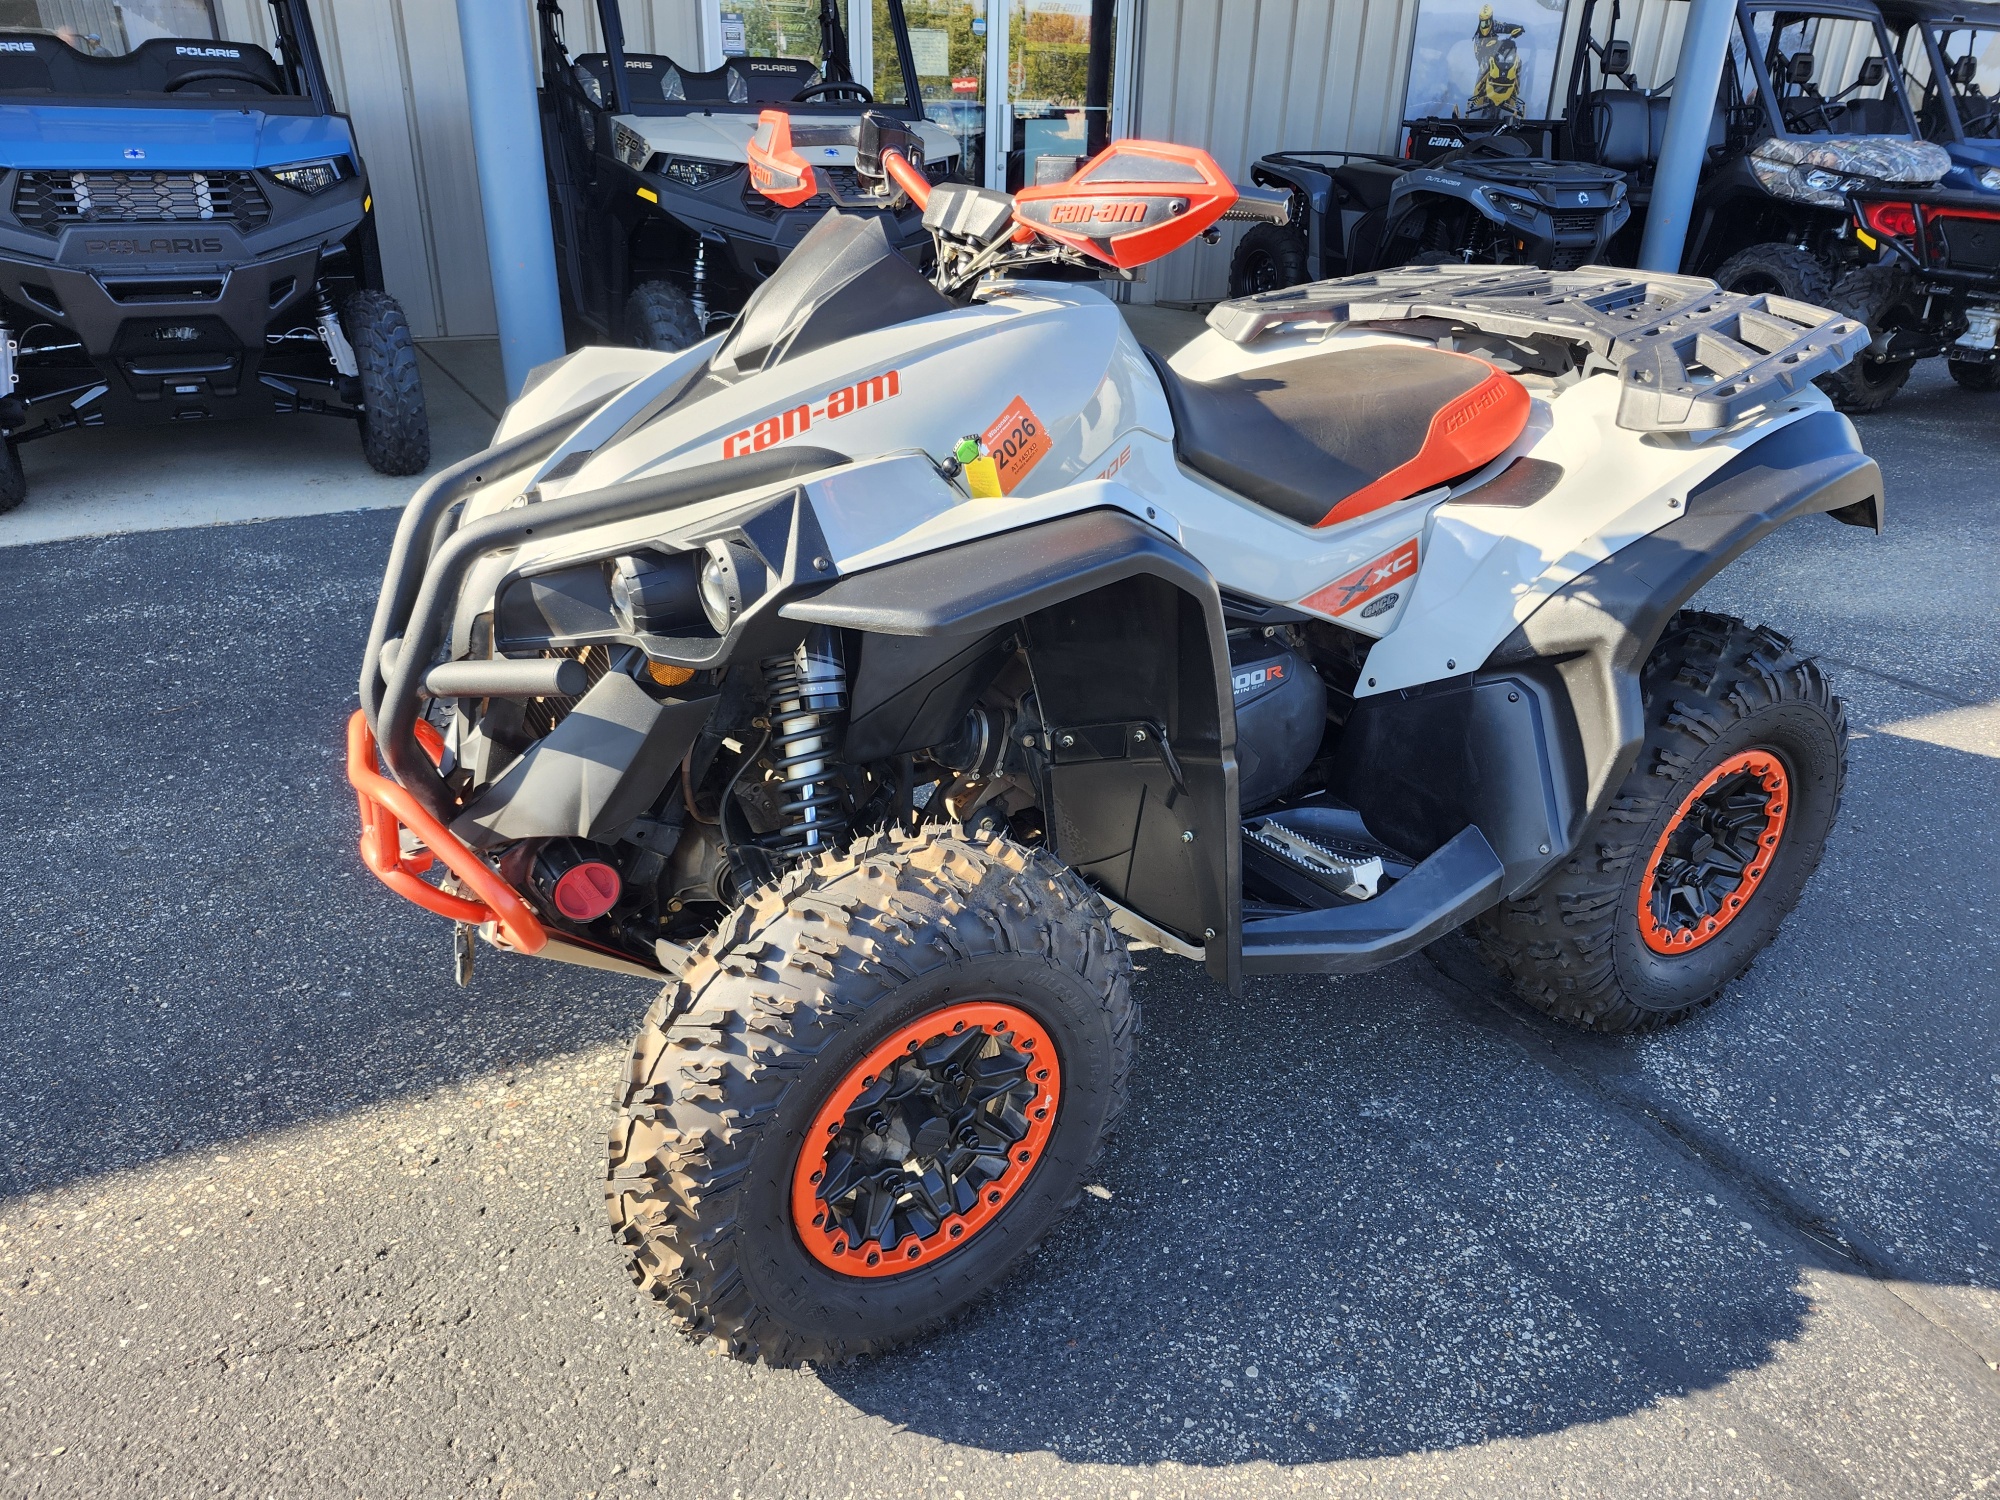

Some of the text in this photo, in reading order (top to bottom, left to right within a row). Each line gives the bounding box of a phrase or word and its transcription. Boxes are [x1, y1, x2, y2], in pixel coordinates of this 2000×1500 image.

[0, 42, 36, 52] ARIS
[176, 46, 240, 58] POLARIS
[602, 60, 653, 70] PARIS
[751, 63, 797, 73] POLARIS
[616, 131, 639, 150] 570
[1425, 175, 1462, 187] OUTLANDER
[1049, 202, 1147, 223] can-am
[85, 238, 223, 255] POLARIS
[723, 370, 900, 460] can-am
[1442, 382, 1508, 436] can-am
[987, 414, 1011, 439] Wisconsin
[993, 417, 1037, 471] 2026
[1011, 461, 1020, 473] AT
